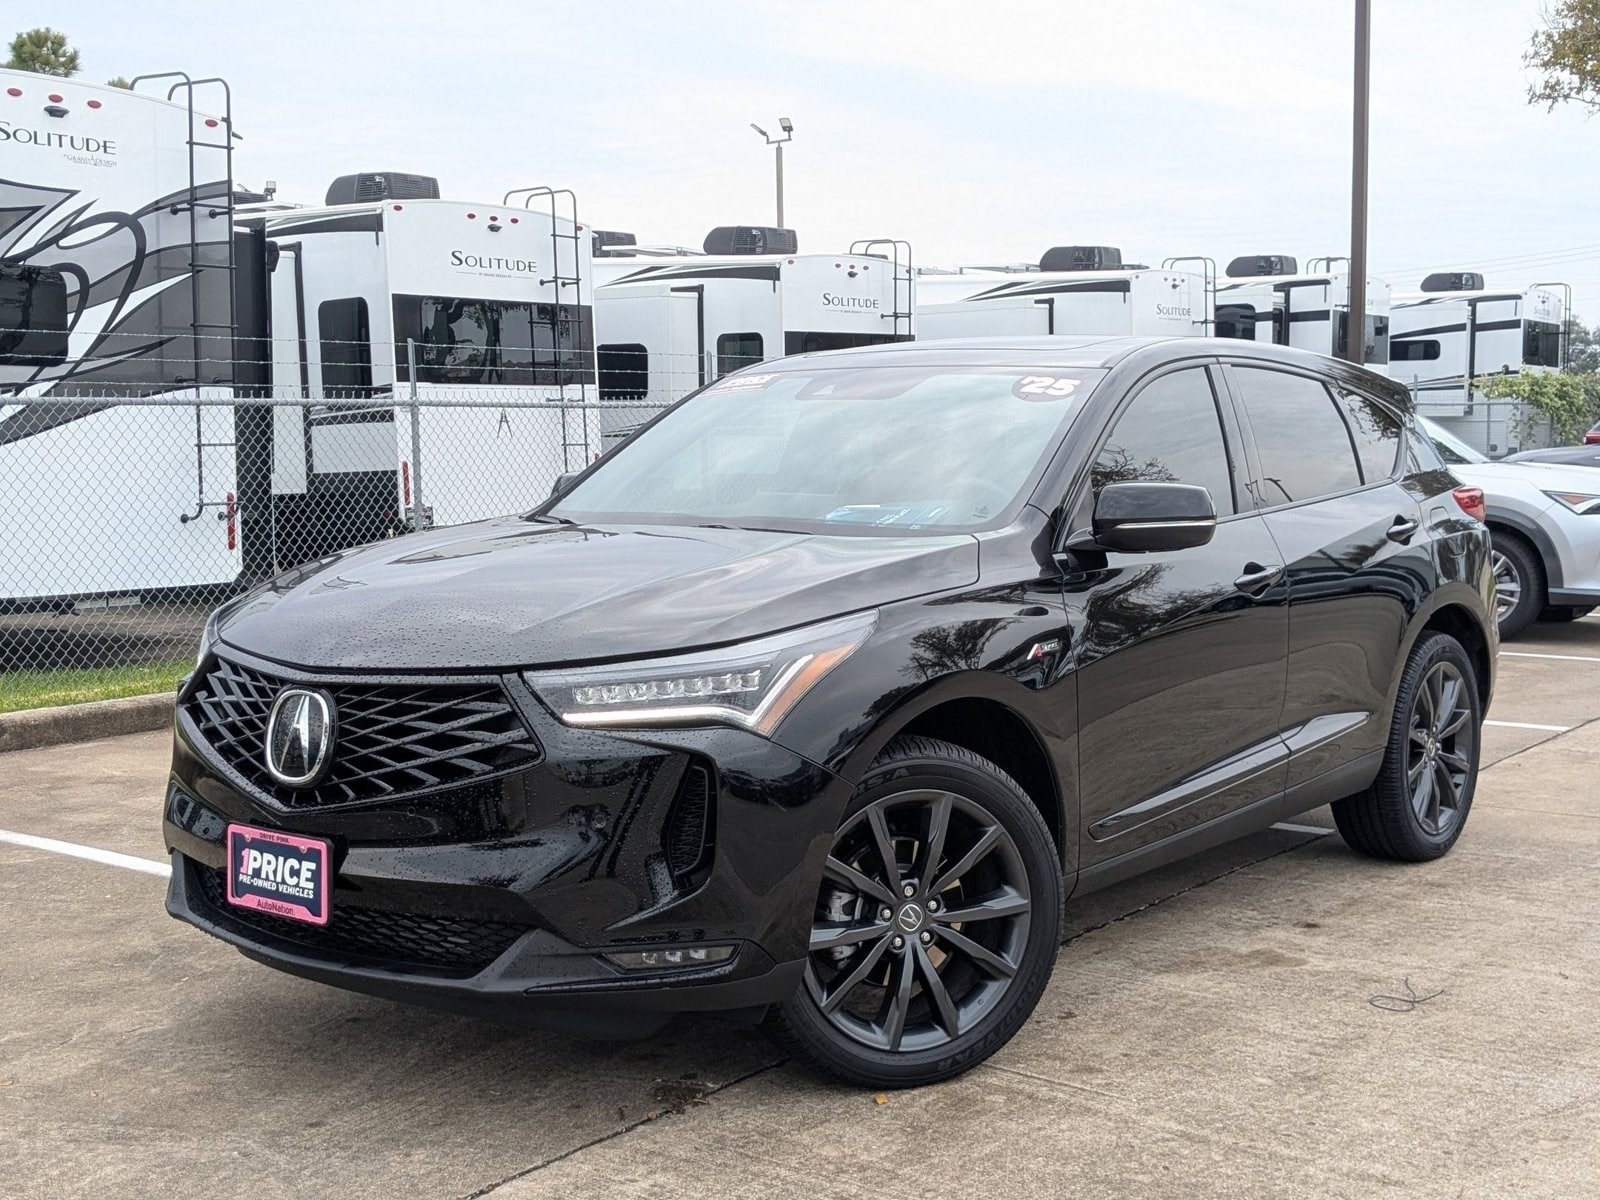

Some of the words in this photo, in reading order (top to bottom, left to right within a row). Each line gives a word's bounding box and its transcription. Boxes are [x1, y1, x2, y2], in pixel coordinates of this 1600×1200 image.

[0, 121, 116, 155] SOLITUDE
[451, 250, 537, 272] SOLITUDE
[822, 292, 879, 309] SOLITUDE
[1156, 303, 1192, 317] SOLITUDE
[240, 848, 316, 889] 1PRICE
[238, 874, 277, 891] PRE-OWNED
[279, 883, 315, 899] VEHICLES
